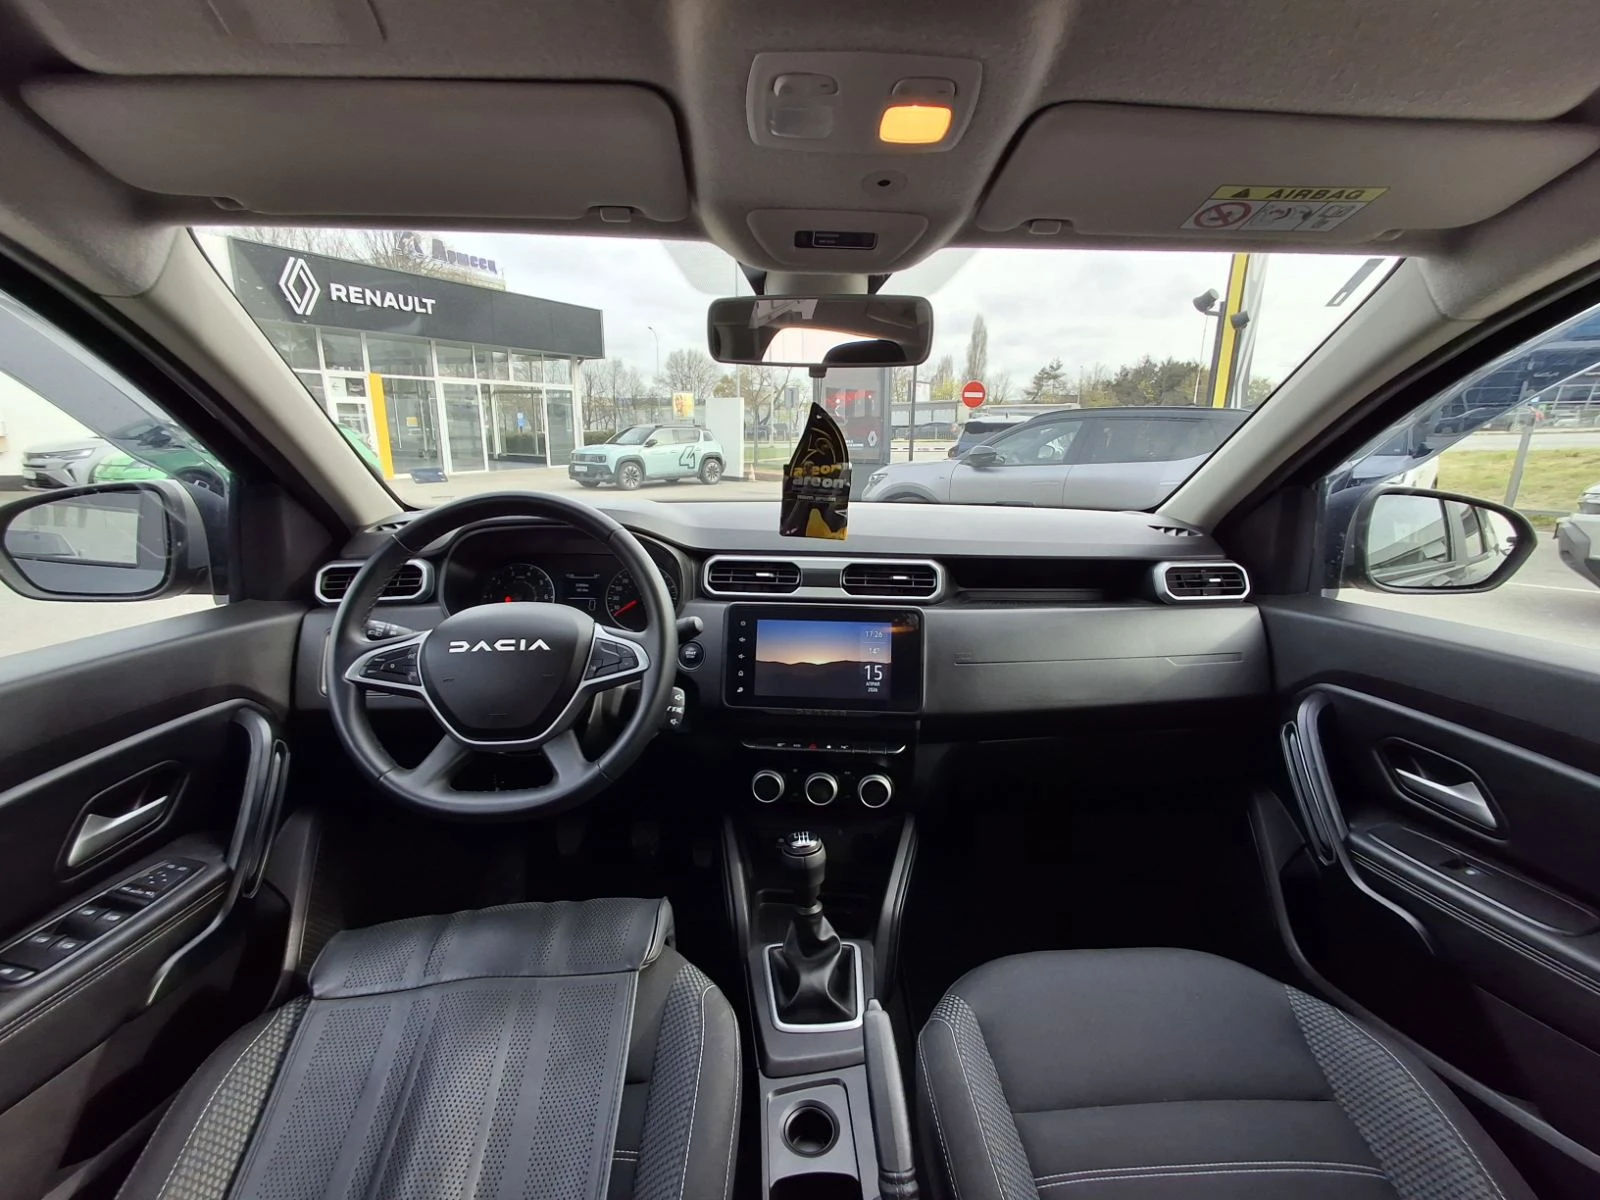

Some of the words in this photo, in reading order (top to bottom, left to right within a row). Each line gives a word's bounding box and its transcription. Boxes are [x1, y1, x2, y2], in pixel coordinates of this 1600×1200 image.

[1265, 188, 1366, 200] AIRBAG
[330, 282, 436, 315] RENAULT
[678, 445, 697, 470] 4
[793, 463, 842, 477] aeon
[448, 638, 551, 653] DACIA
[864, 664, 883, 681] 15
